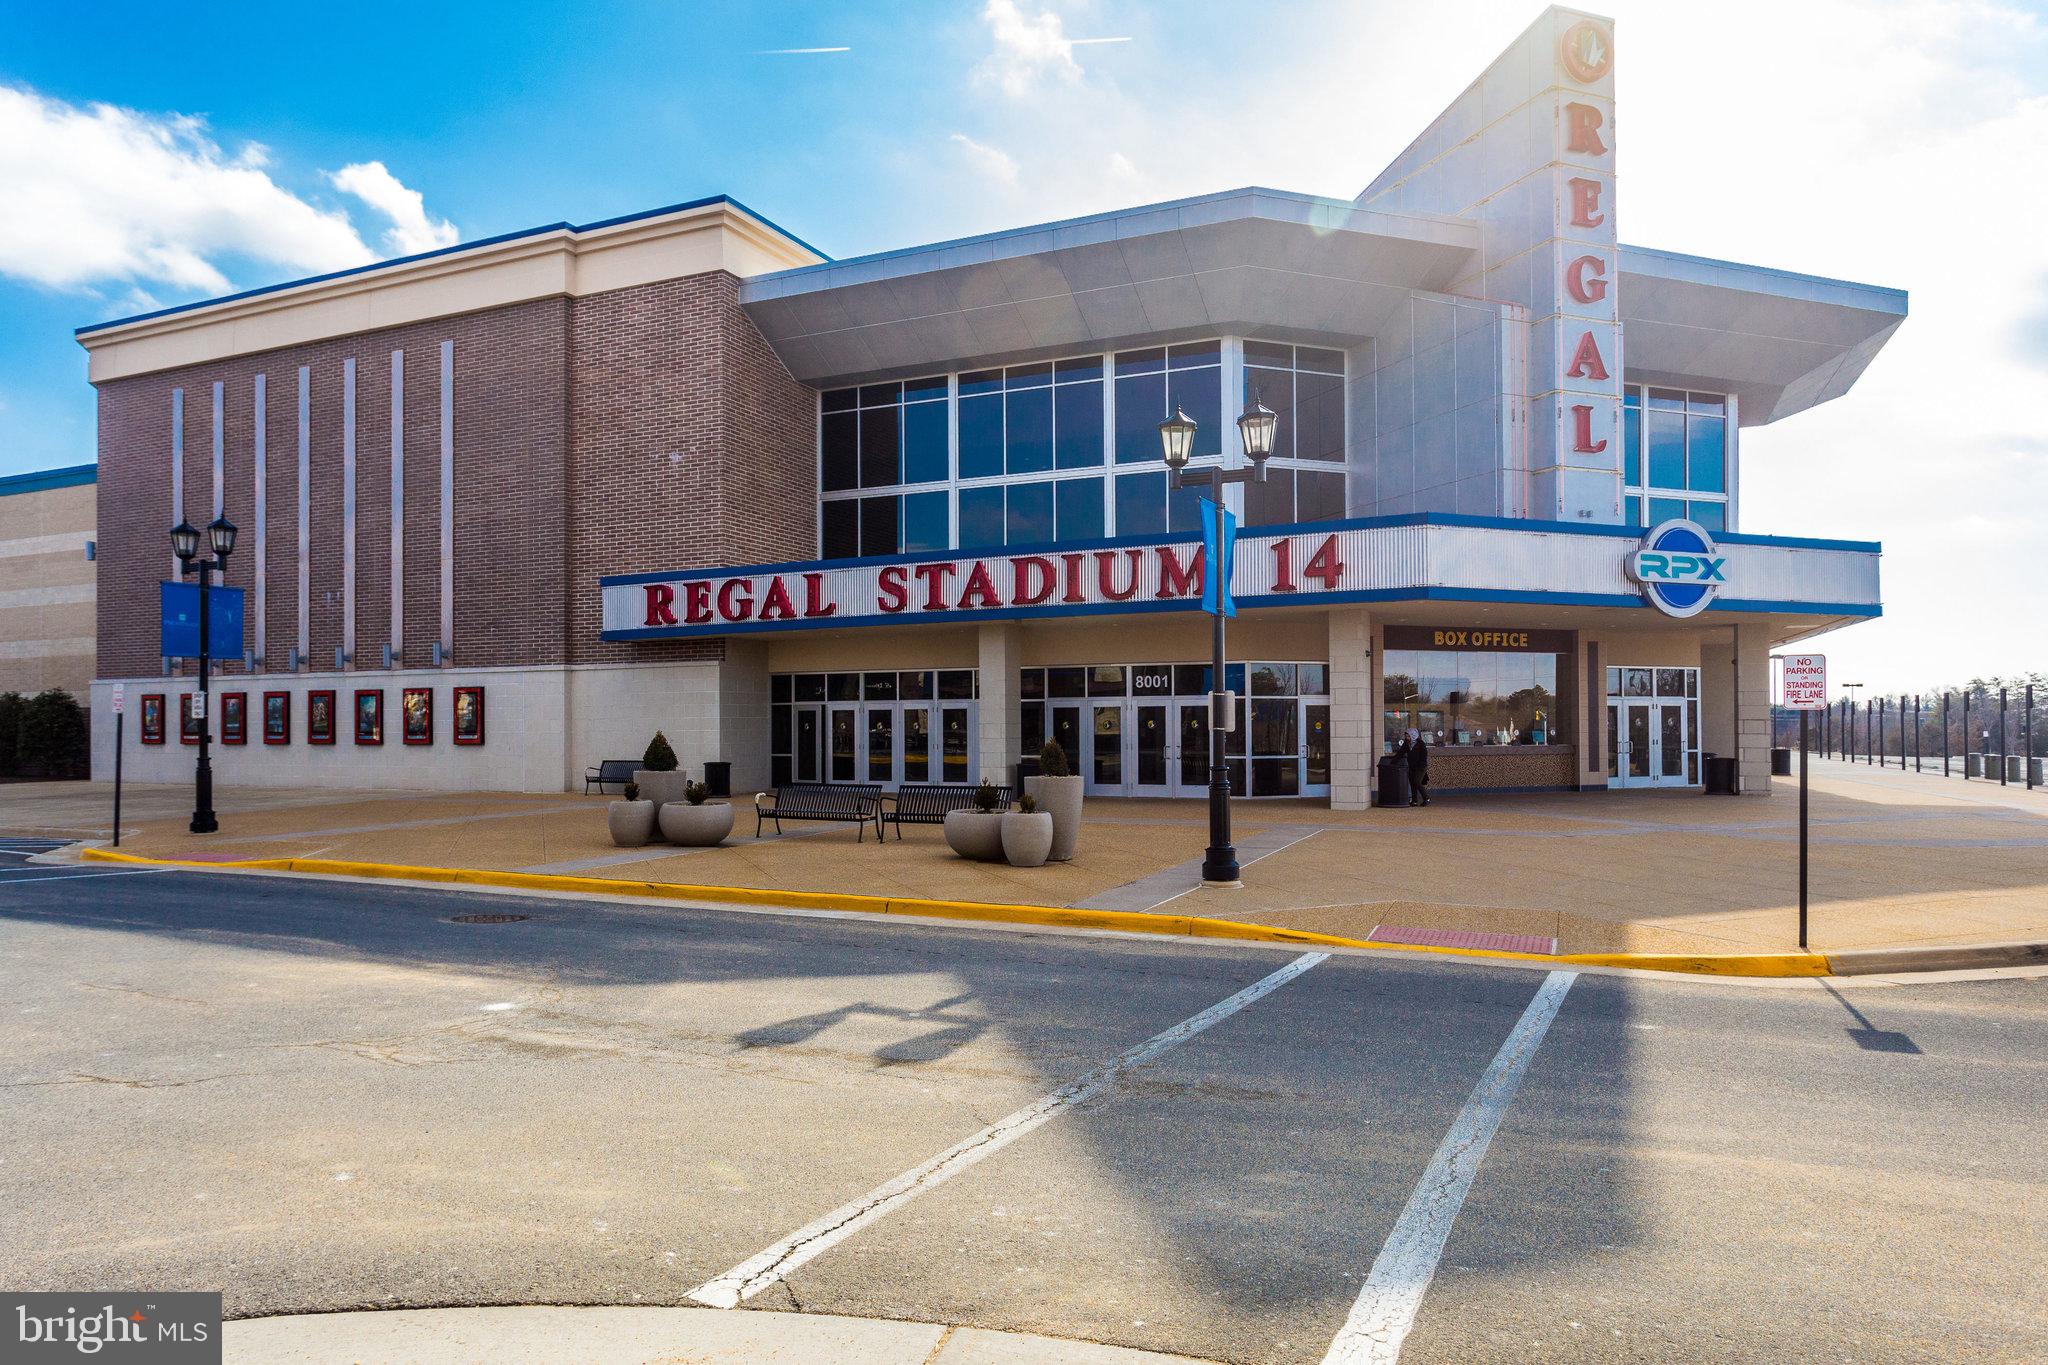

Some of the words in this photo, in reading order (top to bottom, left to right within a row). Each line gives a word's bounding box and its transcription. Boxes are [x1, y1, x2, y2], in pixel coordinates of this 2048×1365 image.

[1566, 101, 1609, 453] REGAL
[1640, 554, 1726, 581] RPX
[643, 574, 836, 626] REGAL
[878, 545, 1204, 612] STADIUM
[1270, 534, 1344, 592] 14
[1434, 631, 1468, 646] BOX
[1472, 632, 1528, 647] OFFICE
[1797, 658, 1812, 666] NO
[1786, 667, 1823, 675] PARKING
[1136, 675, 1168, 688] 8001
[1786, 690, 1802, 698] FIRE
[1804, 690, 1823, 698] LANE
